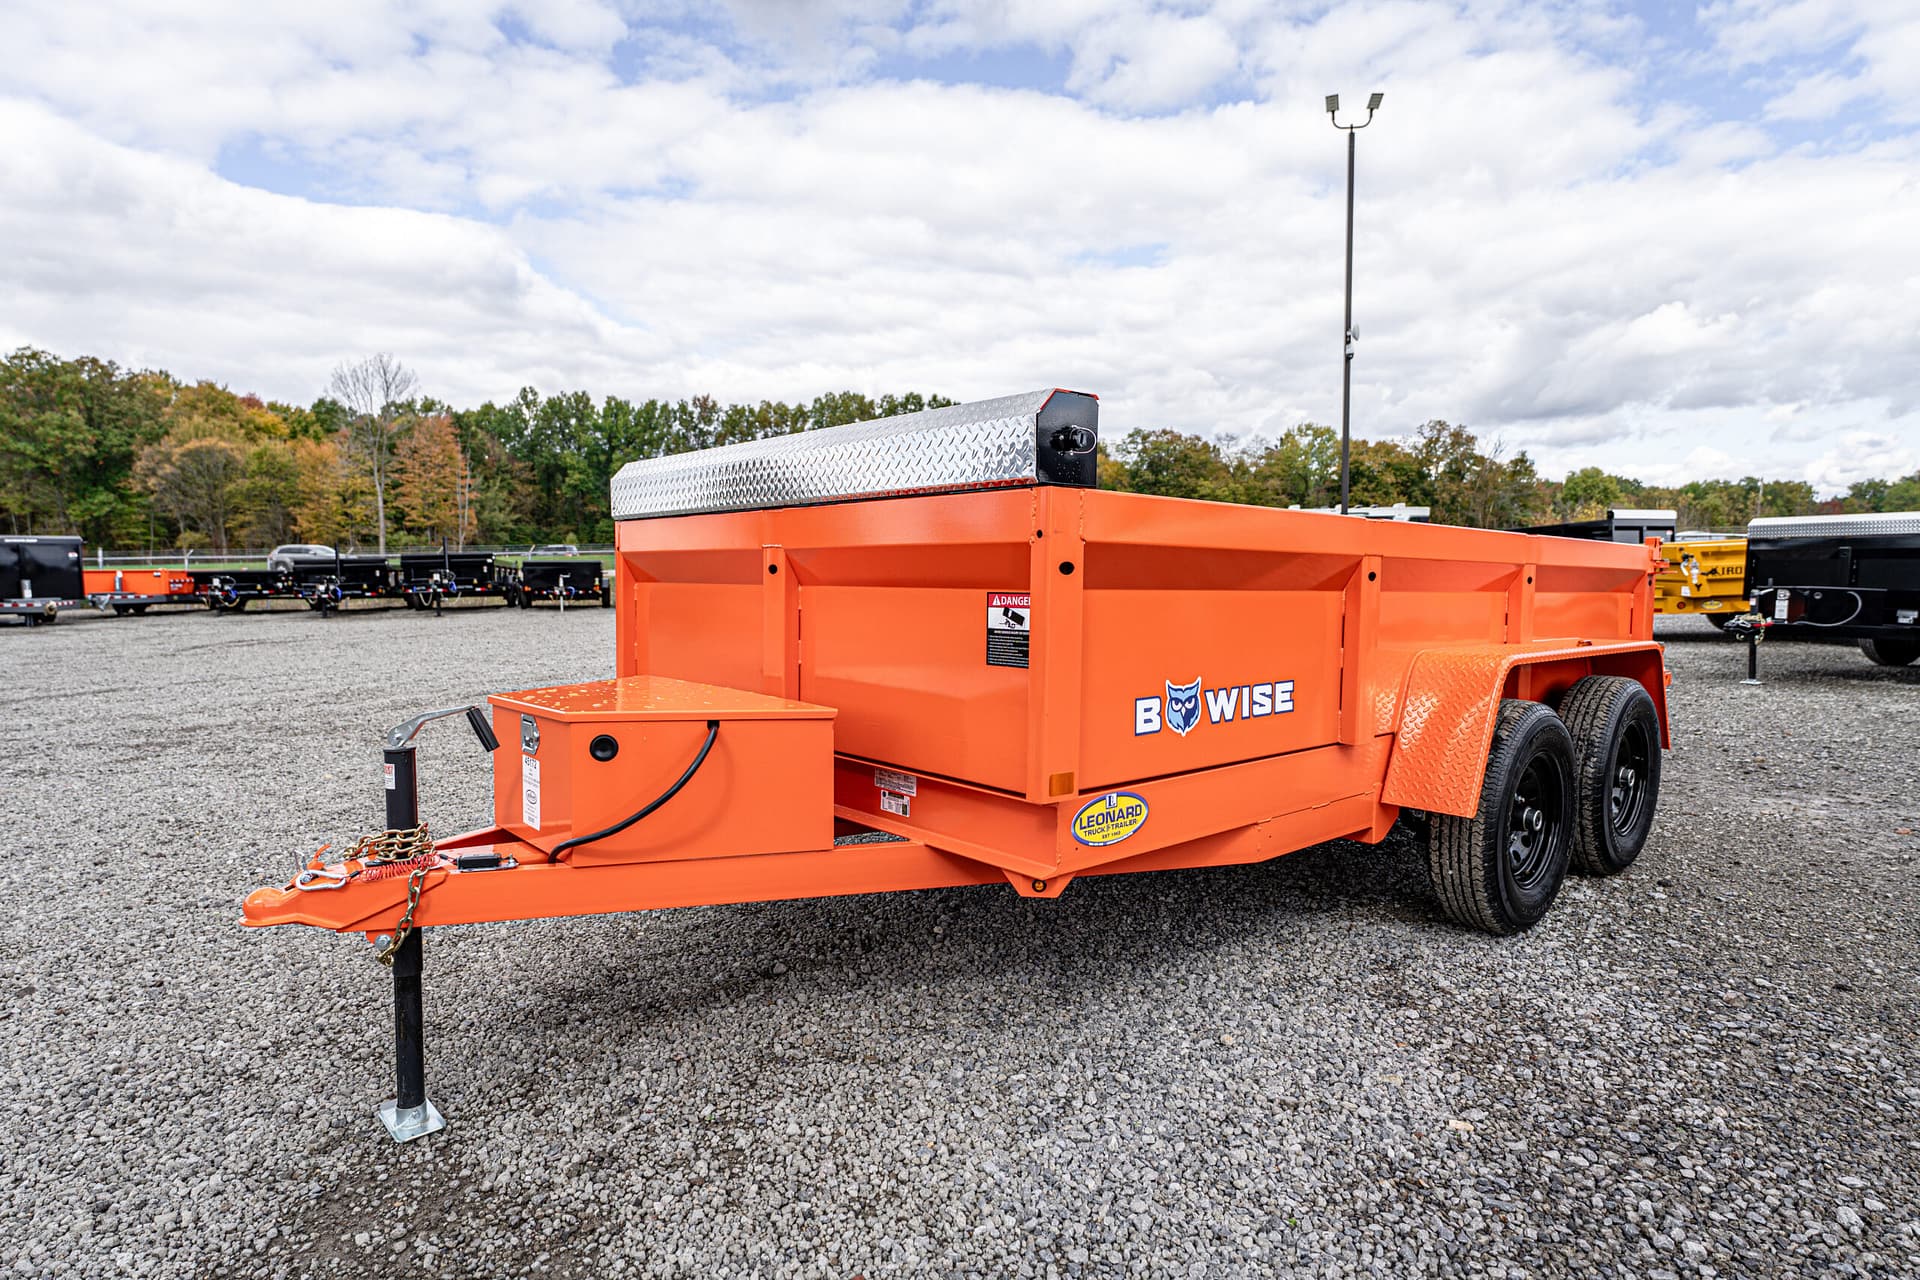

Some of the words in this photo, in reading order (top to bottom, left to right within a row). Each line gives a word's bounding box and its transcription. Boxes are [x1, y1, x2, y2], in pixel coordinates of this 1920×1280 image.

[1001, 596, 1030, 606] DANGE
[1079, 804, 1142, 830] LEONARD
[1083, 826, 1106, 837] TRUCK
[1111, 818, 1137, 831] TRAILER
